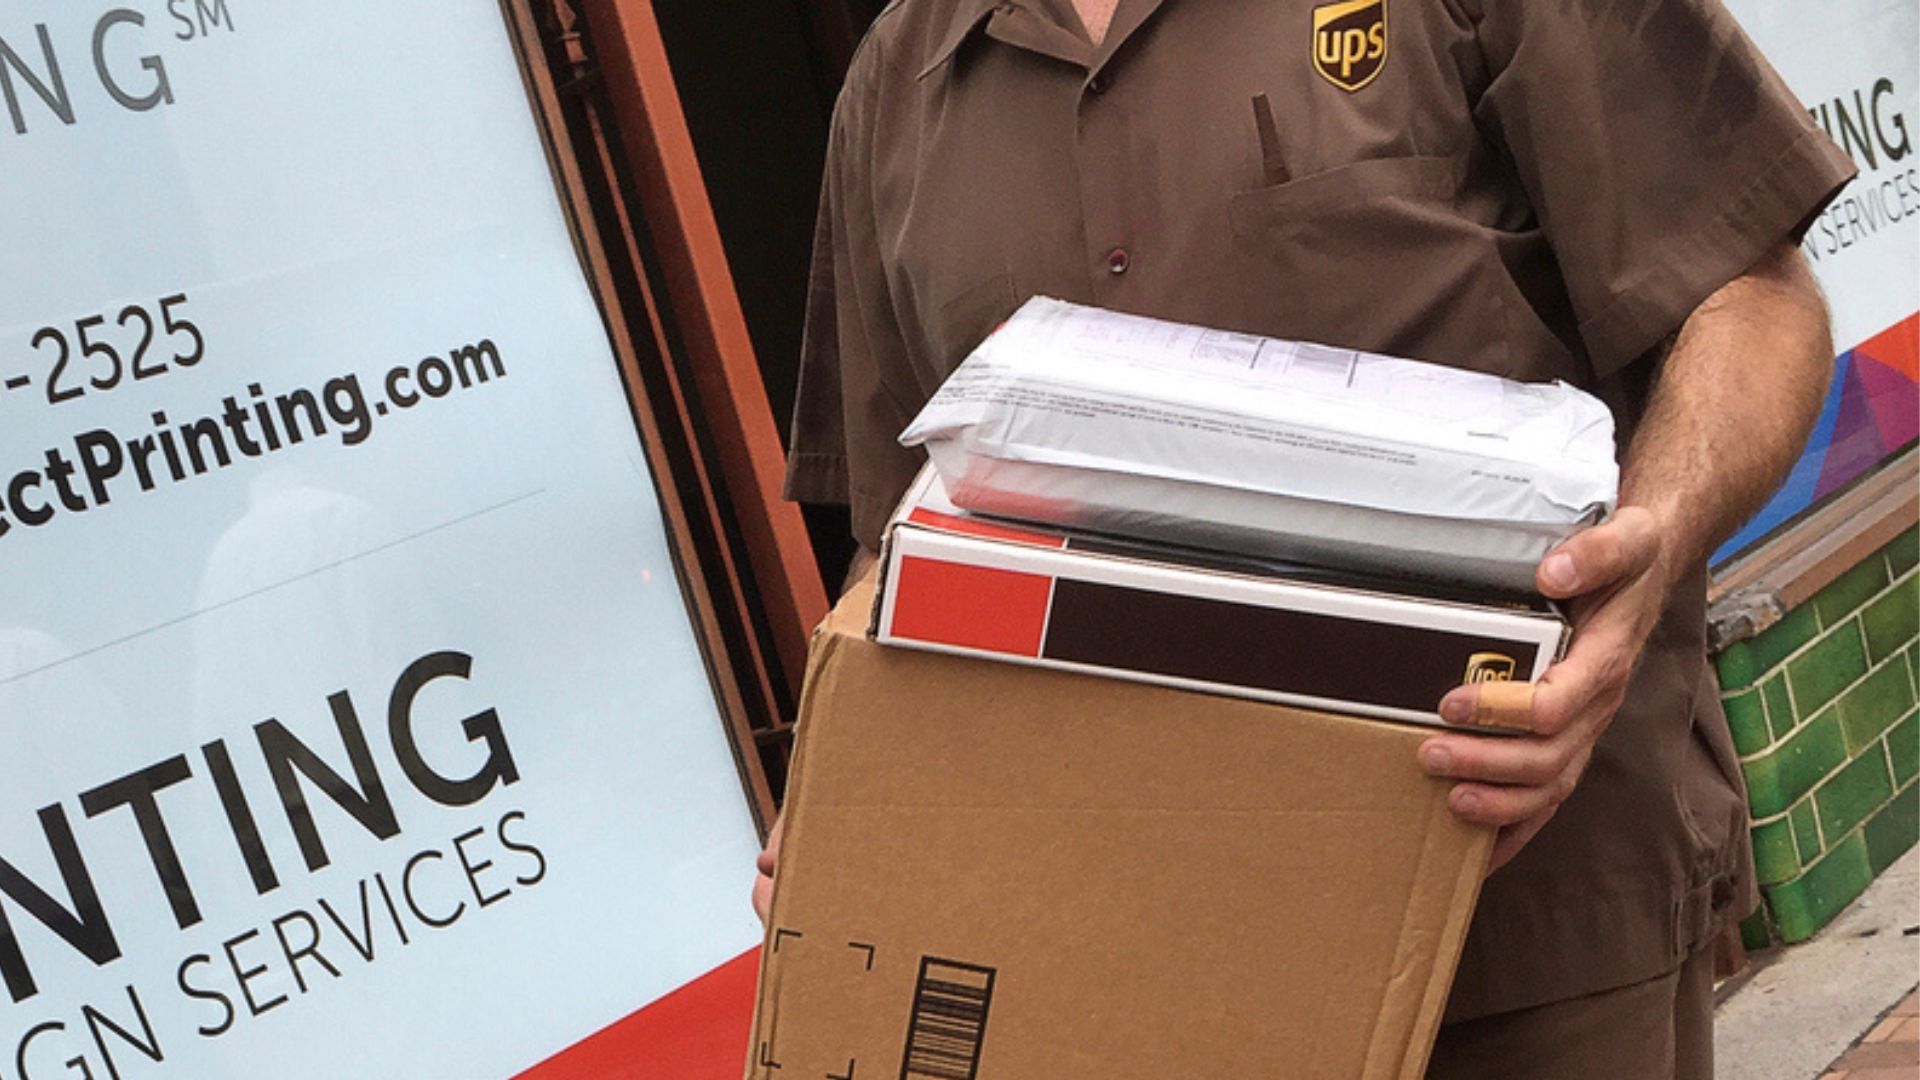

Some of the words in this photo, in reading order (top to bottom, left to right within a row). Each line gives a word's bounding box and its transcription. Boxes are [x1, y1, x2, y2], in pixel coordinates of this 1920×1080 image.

[1319, 21, 1384, 78] ups
[1819, 168, 1920, 254] SERVICES
[4, 293, 205, 405] -2525
[0, 339, 506, 538] ctPrinting.com
[0, 650, 521, 1004] NTING
[0, 984, 164, 1080] GN
[177, 810, 547, 1037] SERVICES
